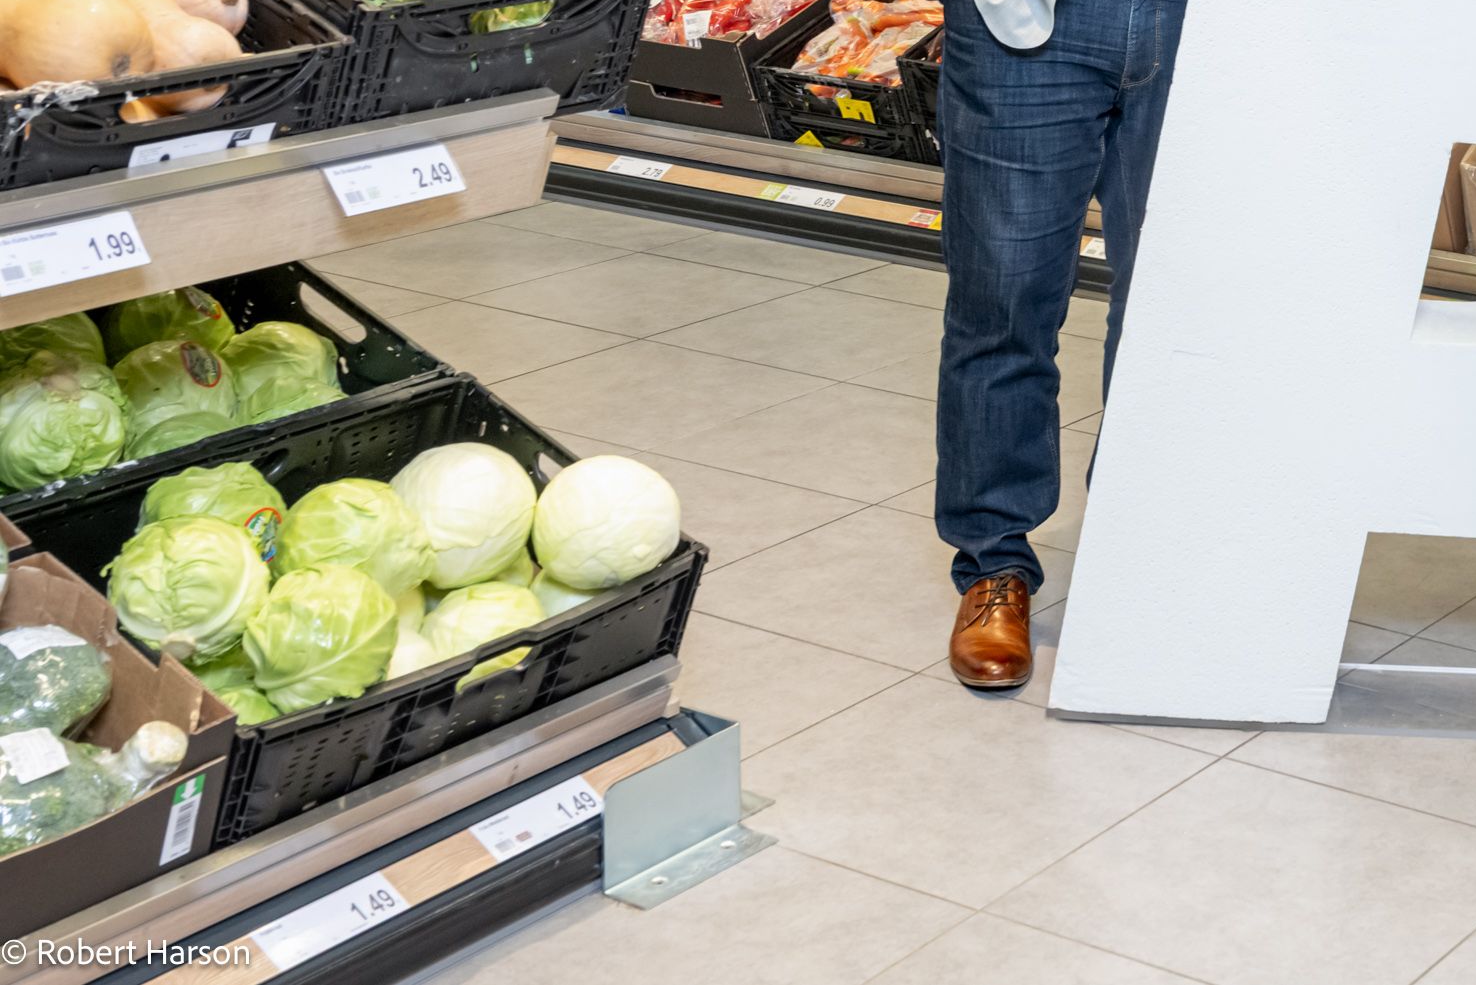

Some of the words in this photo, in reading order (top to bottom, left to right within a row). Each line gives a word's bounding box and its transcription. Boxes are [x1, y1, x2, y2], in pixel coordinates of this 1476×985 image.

[412, 162, 454, 188] 2.49
[641, 167, 664, 178] 2.79
[813, 196, 837, 209] 0.99
[88, 231, 137, 261] 1.99
[555, 790, 598, 821] 1.49
[350, 888, 397, 922] 1.49
